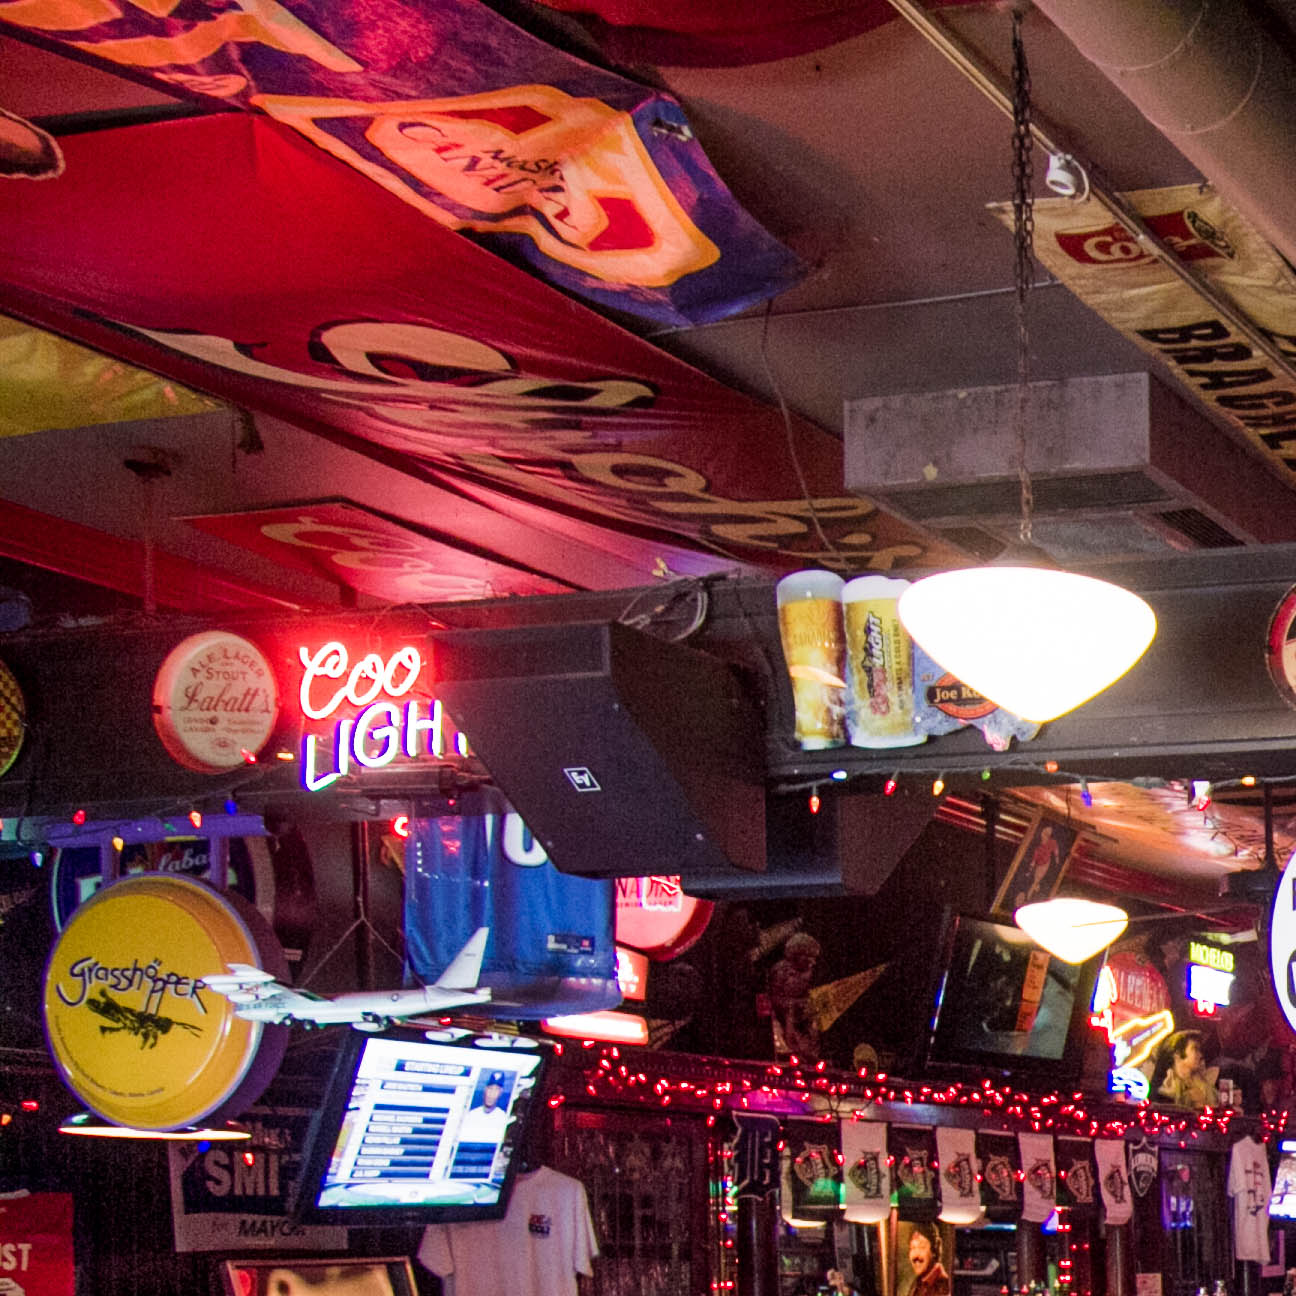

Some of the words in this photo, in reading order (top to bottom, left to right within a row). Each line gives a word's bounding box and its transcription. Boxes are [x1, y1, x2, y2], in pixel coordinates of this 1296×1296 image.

[299, 640, 422, 720] Coo
[300, 699, 469, 793] LIGH
[203, 1148, 282, 1197] SMI
